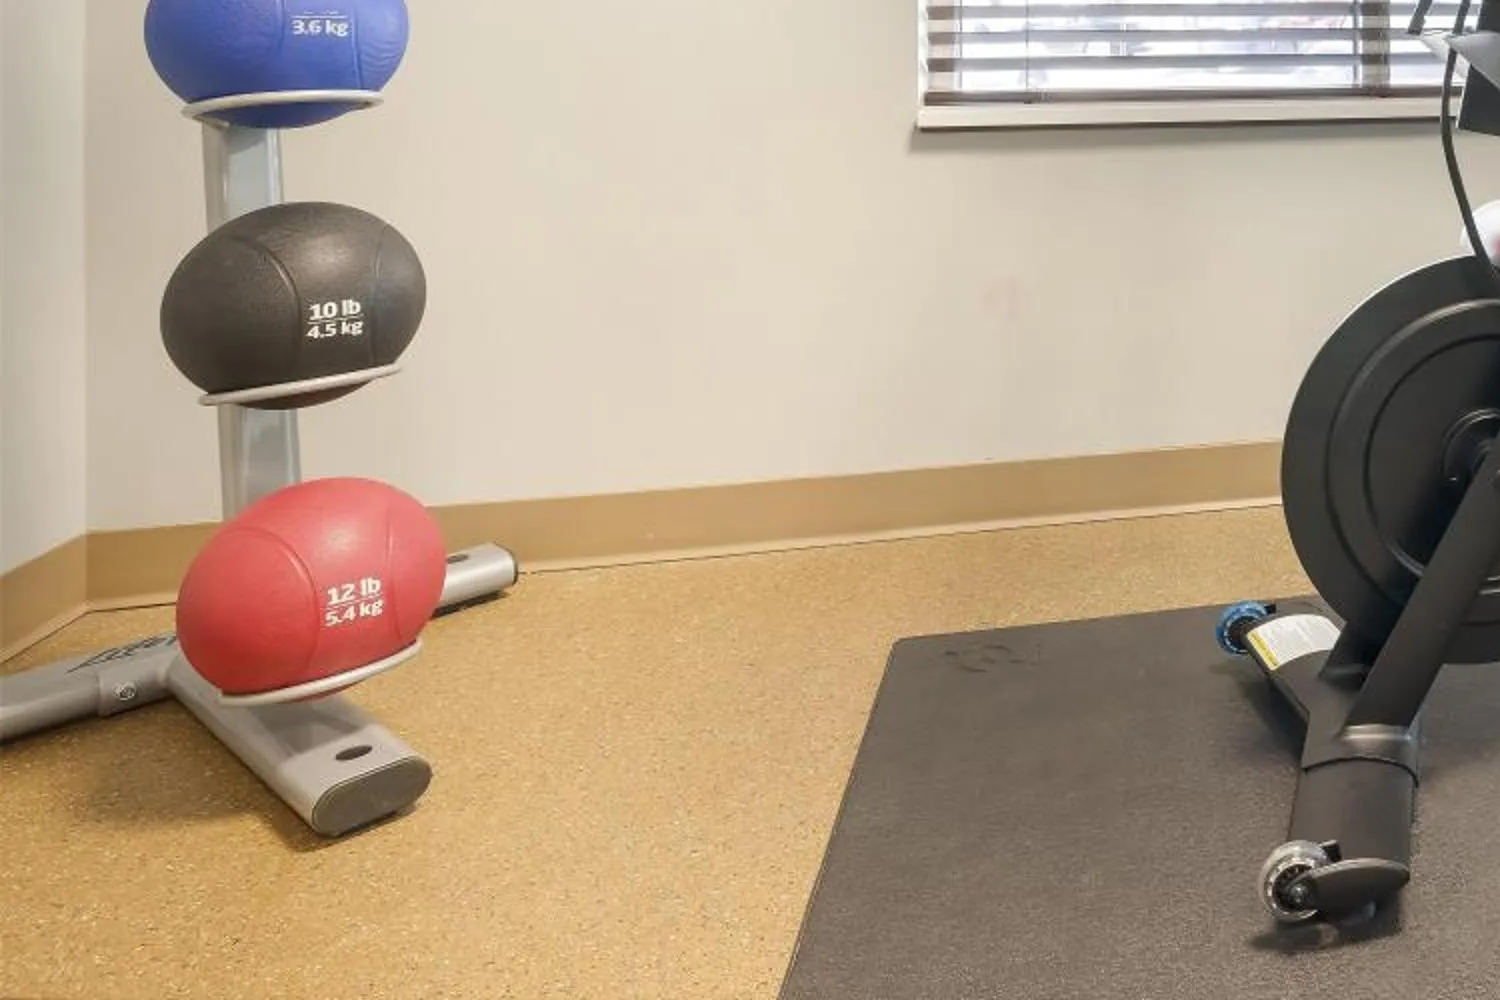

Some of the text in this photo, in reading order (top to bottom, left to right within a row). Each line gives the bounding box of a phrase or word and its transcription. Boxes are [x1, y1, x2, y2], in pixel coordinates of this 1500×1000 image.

[291, 19, 349, 37] 3.6 kg
[309, 299, 361, 321] 10 lb
[306, 320, 363, 339] 4.5 kg
[327, 577, 382, 605] 12 lb
[325, 600, 384, 627] 5.4 kg
